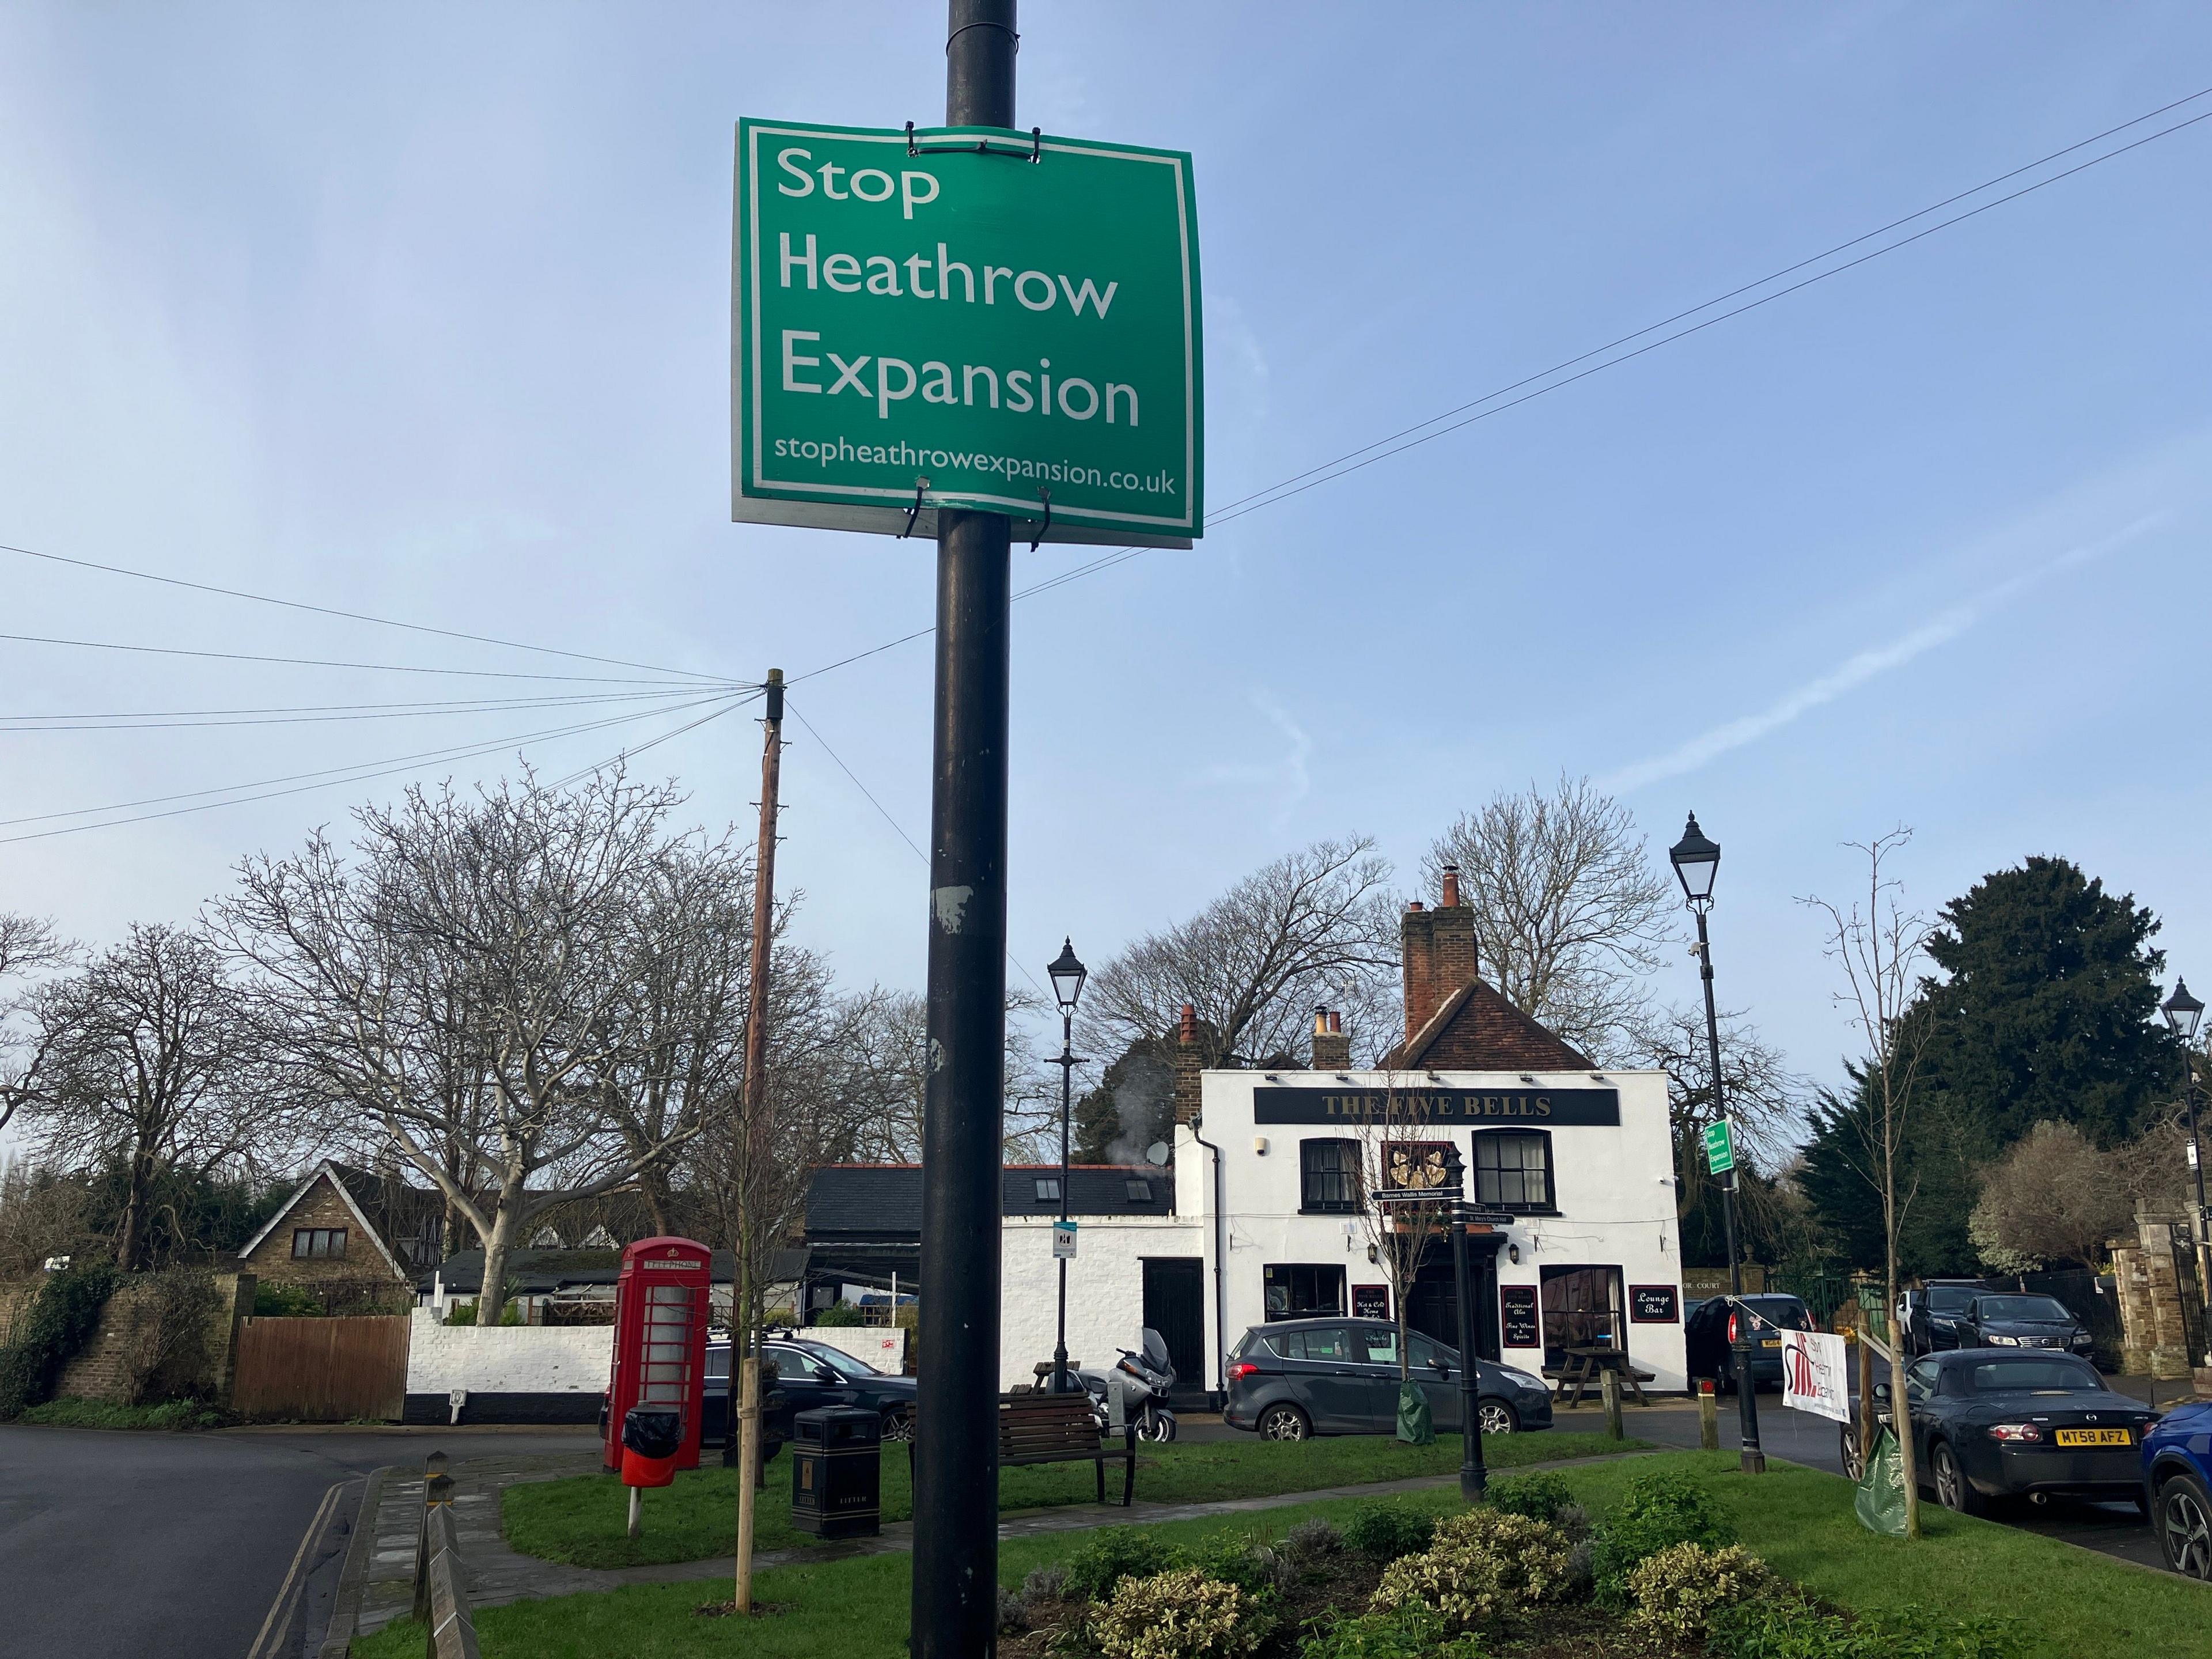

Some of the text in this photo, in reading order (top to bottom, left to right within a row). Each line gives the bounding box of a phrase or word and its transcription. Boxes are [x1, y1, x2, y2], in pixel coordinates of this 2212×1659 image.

[778, 147, 940, 219] Stop
[779, 232, 1118, 320] Heathrow
[782, 329, 1139, 427] Expansion
[774, 436, 1176, 495] stopheathrowexpansion.co.uk
[1321, 1096, 1551, 1116] THE FIVE BELLS
[1638, 1293, 1669, 1305] Lounge
[1645, 1304, 1664, 1313] Bar
[1513, 1333, 1529, 1341] Spirits
[2061, 1430, 2124, 1443] MT58 AFZ
